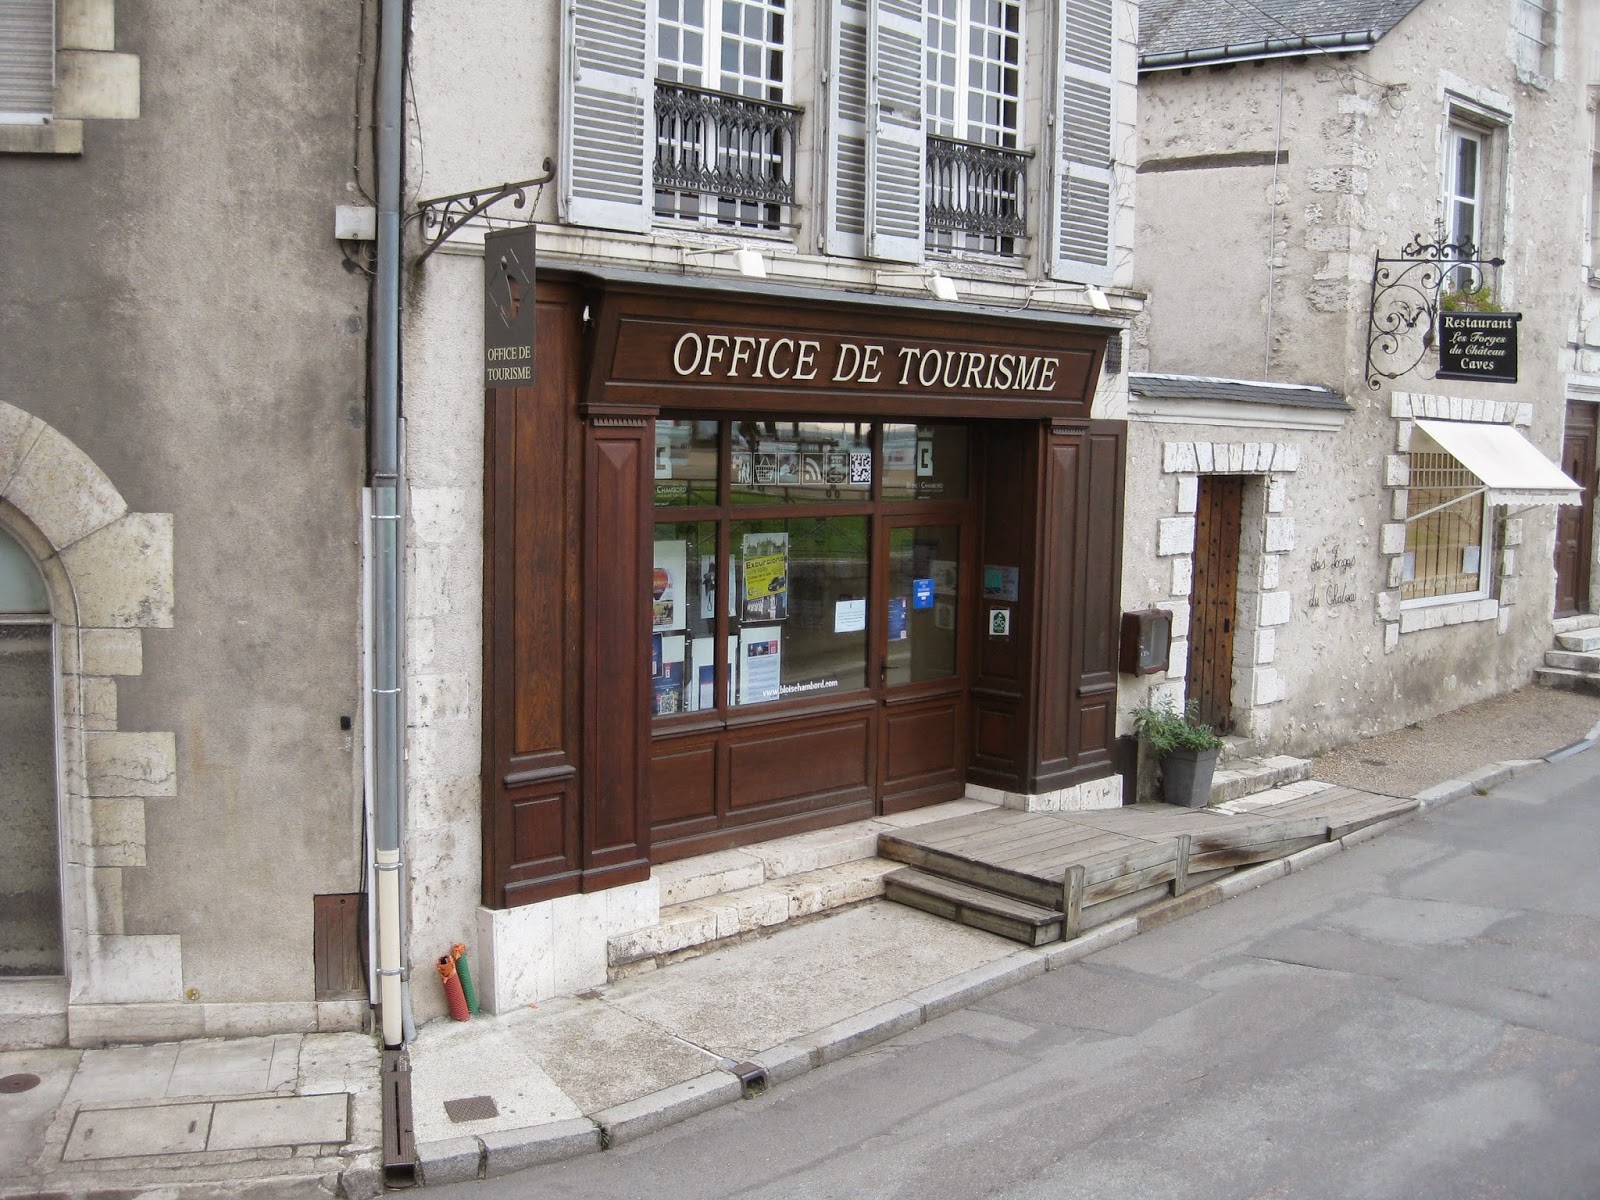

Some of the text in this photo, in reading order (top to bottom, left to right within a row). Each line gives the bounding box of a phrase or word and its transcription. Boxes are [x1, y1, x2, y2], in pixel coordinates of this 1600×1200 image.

[1444, 316, 1513, 329] Restaurant
[1449, 331, 1507, 347] Les Forges
[487, 345, 532, 361] OFFICE DE
[1449, 344, 1507, 356] du Château
[673, 331, 1060, 392] OFFICE DE TOURISME
[1460, 357, 1495, 370] Caves
[487, 366, 532, 381] TOURISME
